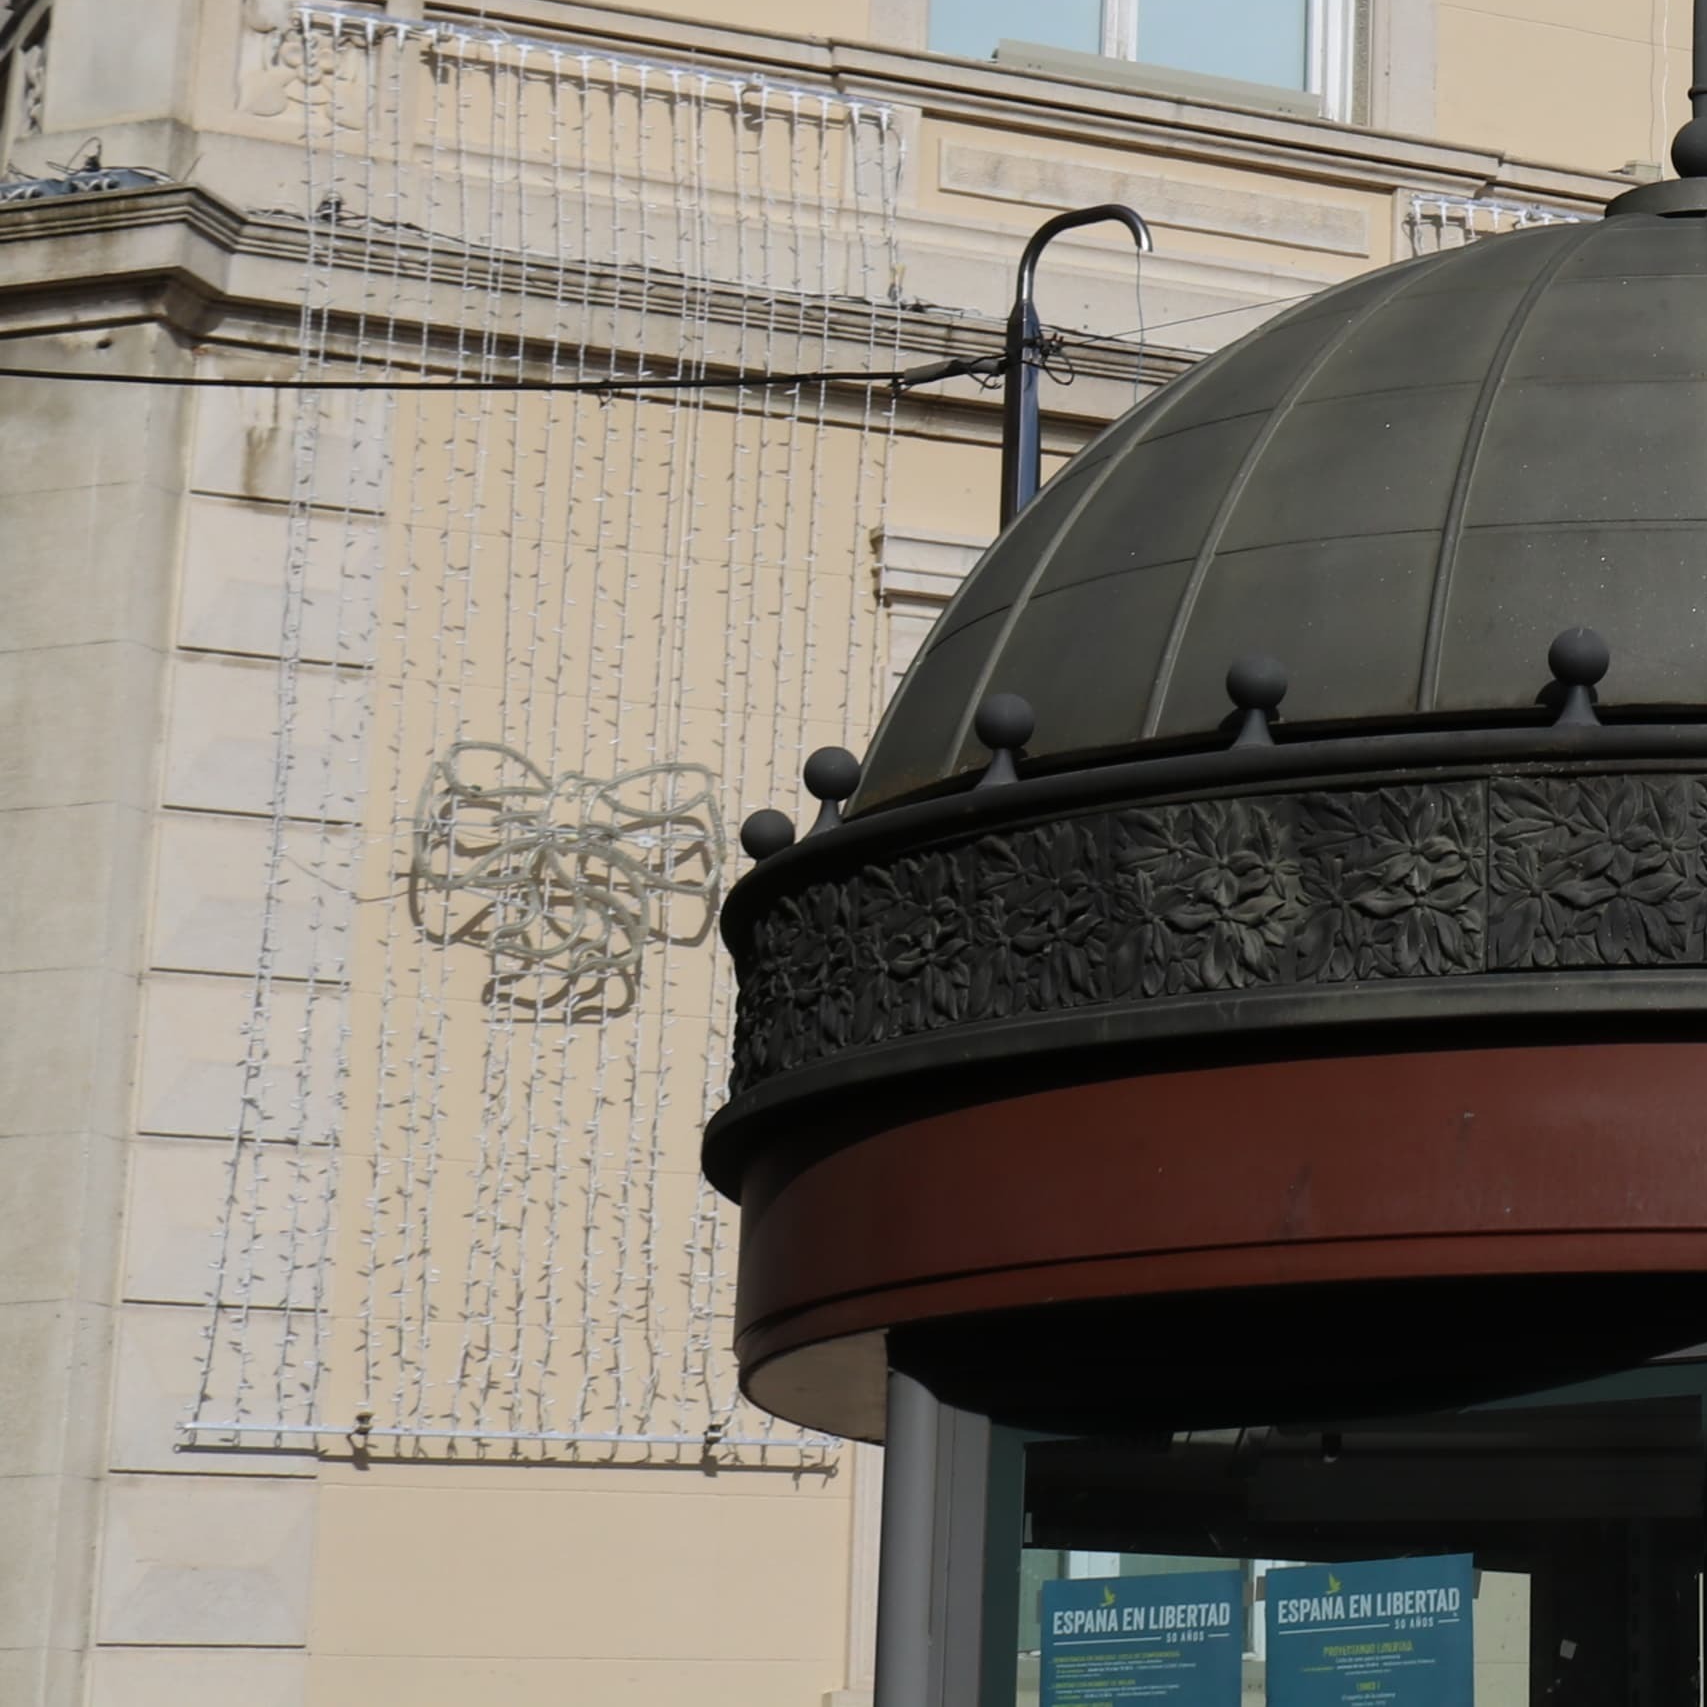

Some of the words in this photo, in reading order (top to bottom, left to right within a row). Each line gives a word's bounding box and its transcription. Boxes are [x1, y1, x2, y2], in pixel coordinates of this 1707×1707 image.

[1349, 1594, 1372, 1618] EN
[1377, 1588, 1460, 1616] LIBERTAD
[1122, 1607, 1145, 1631] EN
[1149, 1603, 1231, 1630] LIBERTAD
[1395, 1619, 1406, 1629] 50
[1410, 1617, 1434, 1628] AÑOS
[1166, 1633, 1177, 1643] 50
[1180, 1631, 1205, 1642] AÑOS
